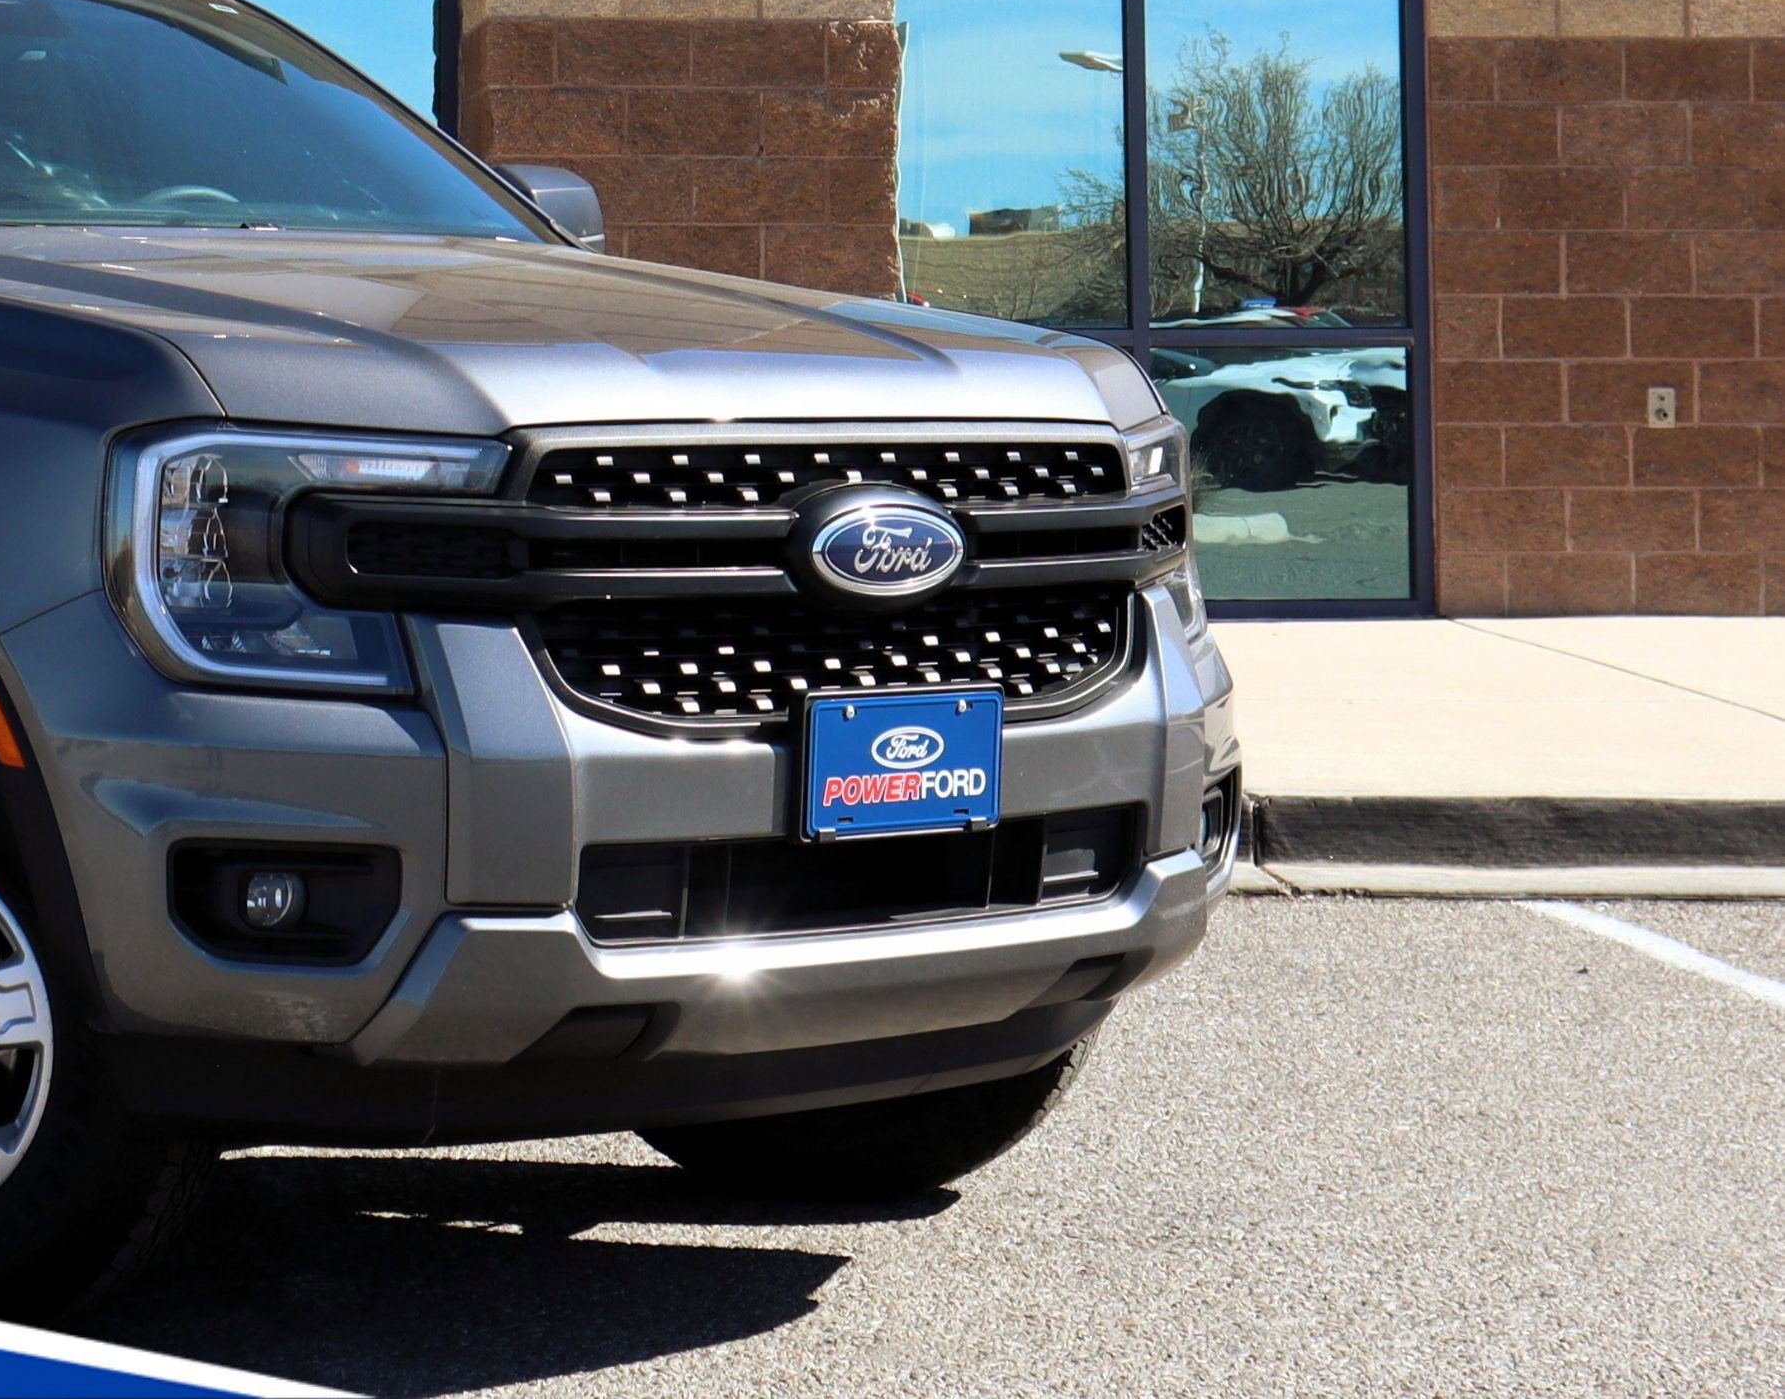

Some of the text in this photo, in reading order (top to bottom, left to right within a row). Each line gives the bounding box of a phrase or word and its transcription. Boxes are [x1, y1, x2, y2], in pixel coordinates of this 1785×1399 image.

[854, 526, 933, 574] Ford
[885, 734, 928, 762] Ford
[823, 768, 986, 807] POWERFORD
